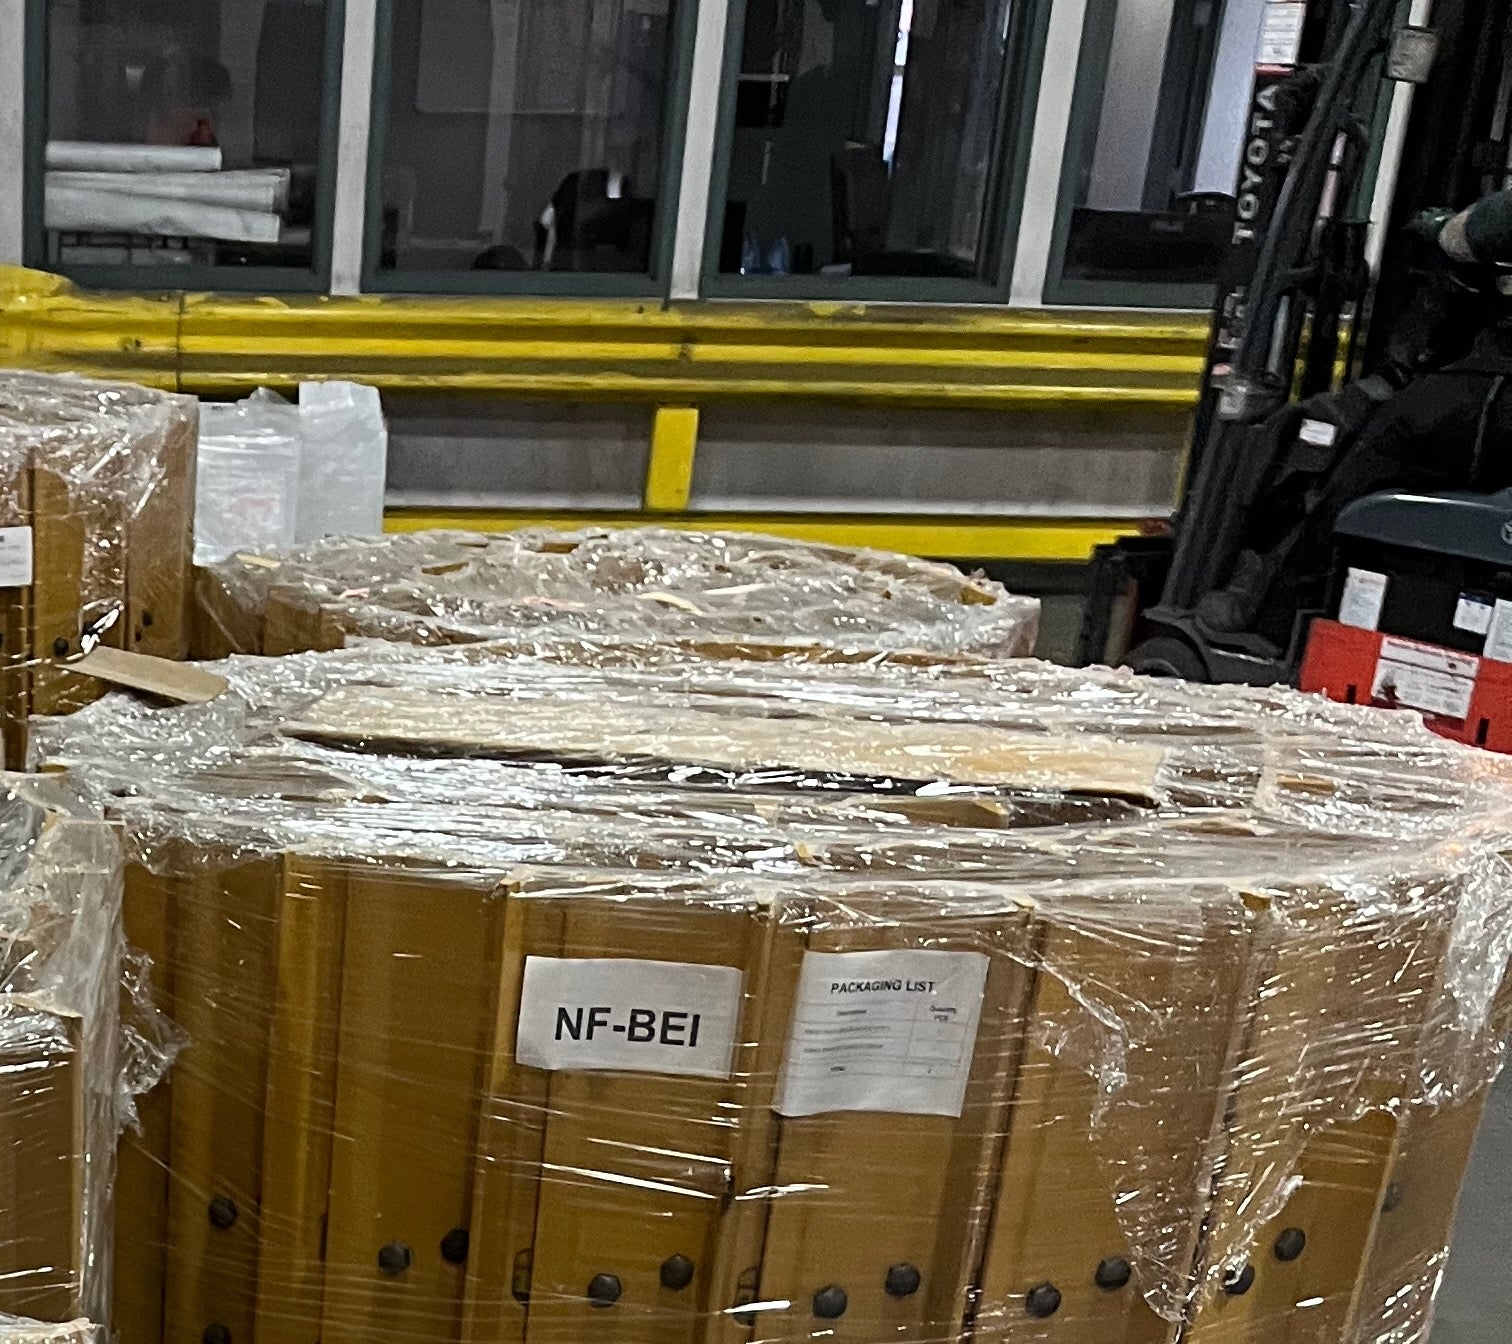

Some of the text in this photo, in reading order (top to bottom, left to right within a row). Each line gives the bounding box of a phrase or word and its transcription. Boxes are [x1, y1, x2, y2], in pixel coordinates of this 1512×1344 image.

[1232, 85, 1279, 244] TOYOTA
[830, 980, 936, 994] PACKAGING LIST
[554, 1006, 701, 1047] NF-BEI
